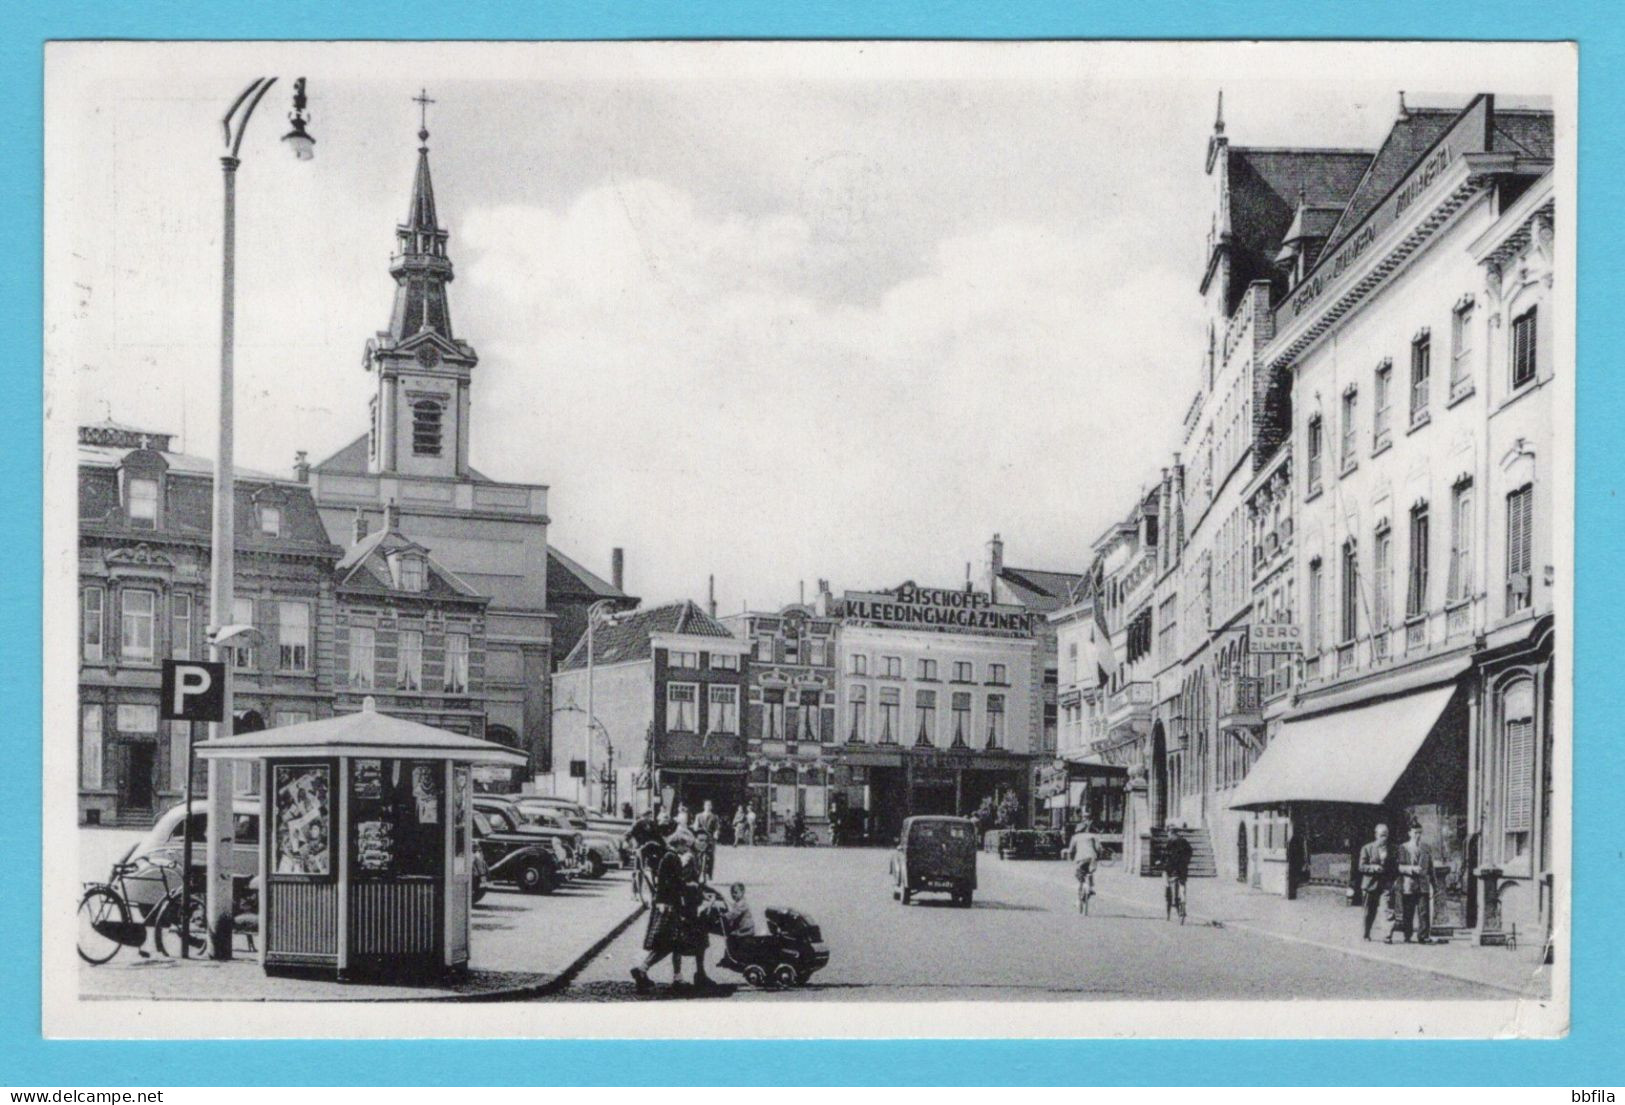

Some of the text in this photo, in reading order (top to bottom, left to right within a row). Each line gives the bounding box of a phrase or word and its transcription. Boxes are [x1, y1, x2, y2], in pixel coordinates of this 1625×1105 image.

[1254, 627, 1301, 638] GERO
[1251, 641, 1303, 651] ZILMETA
[173, 665, 211, 714] P
